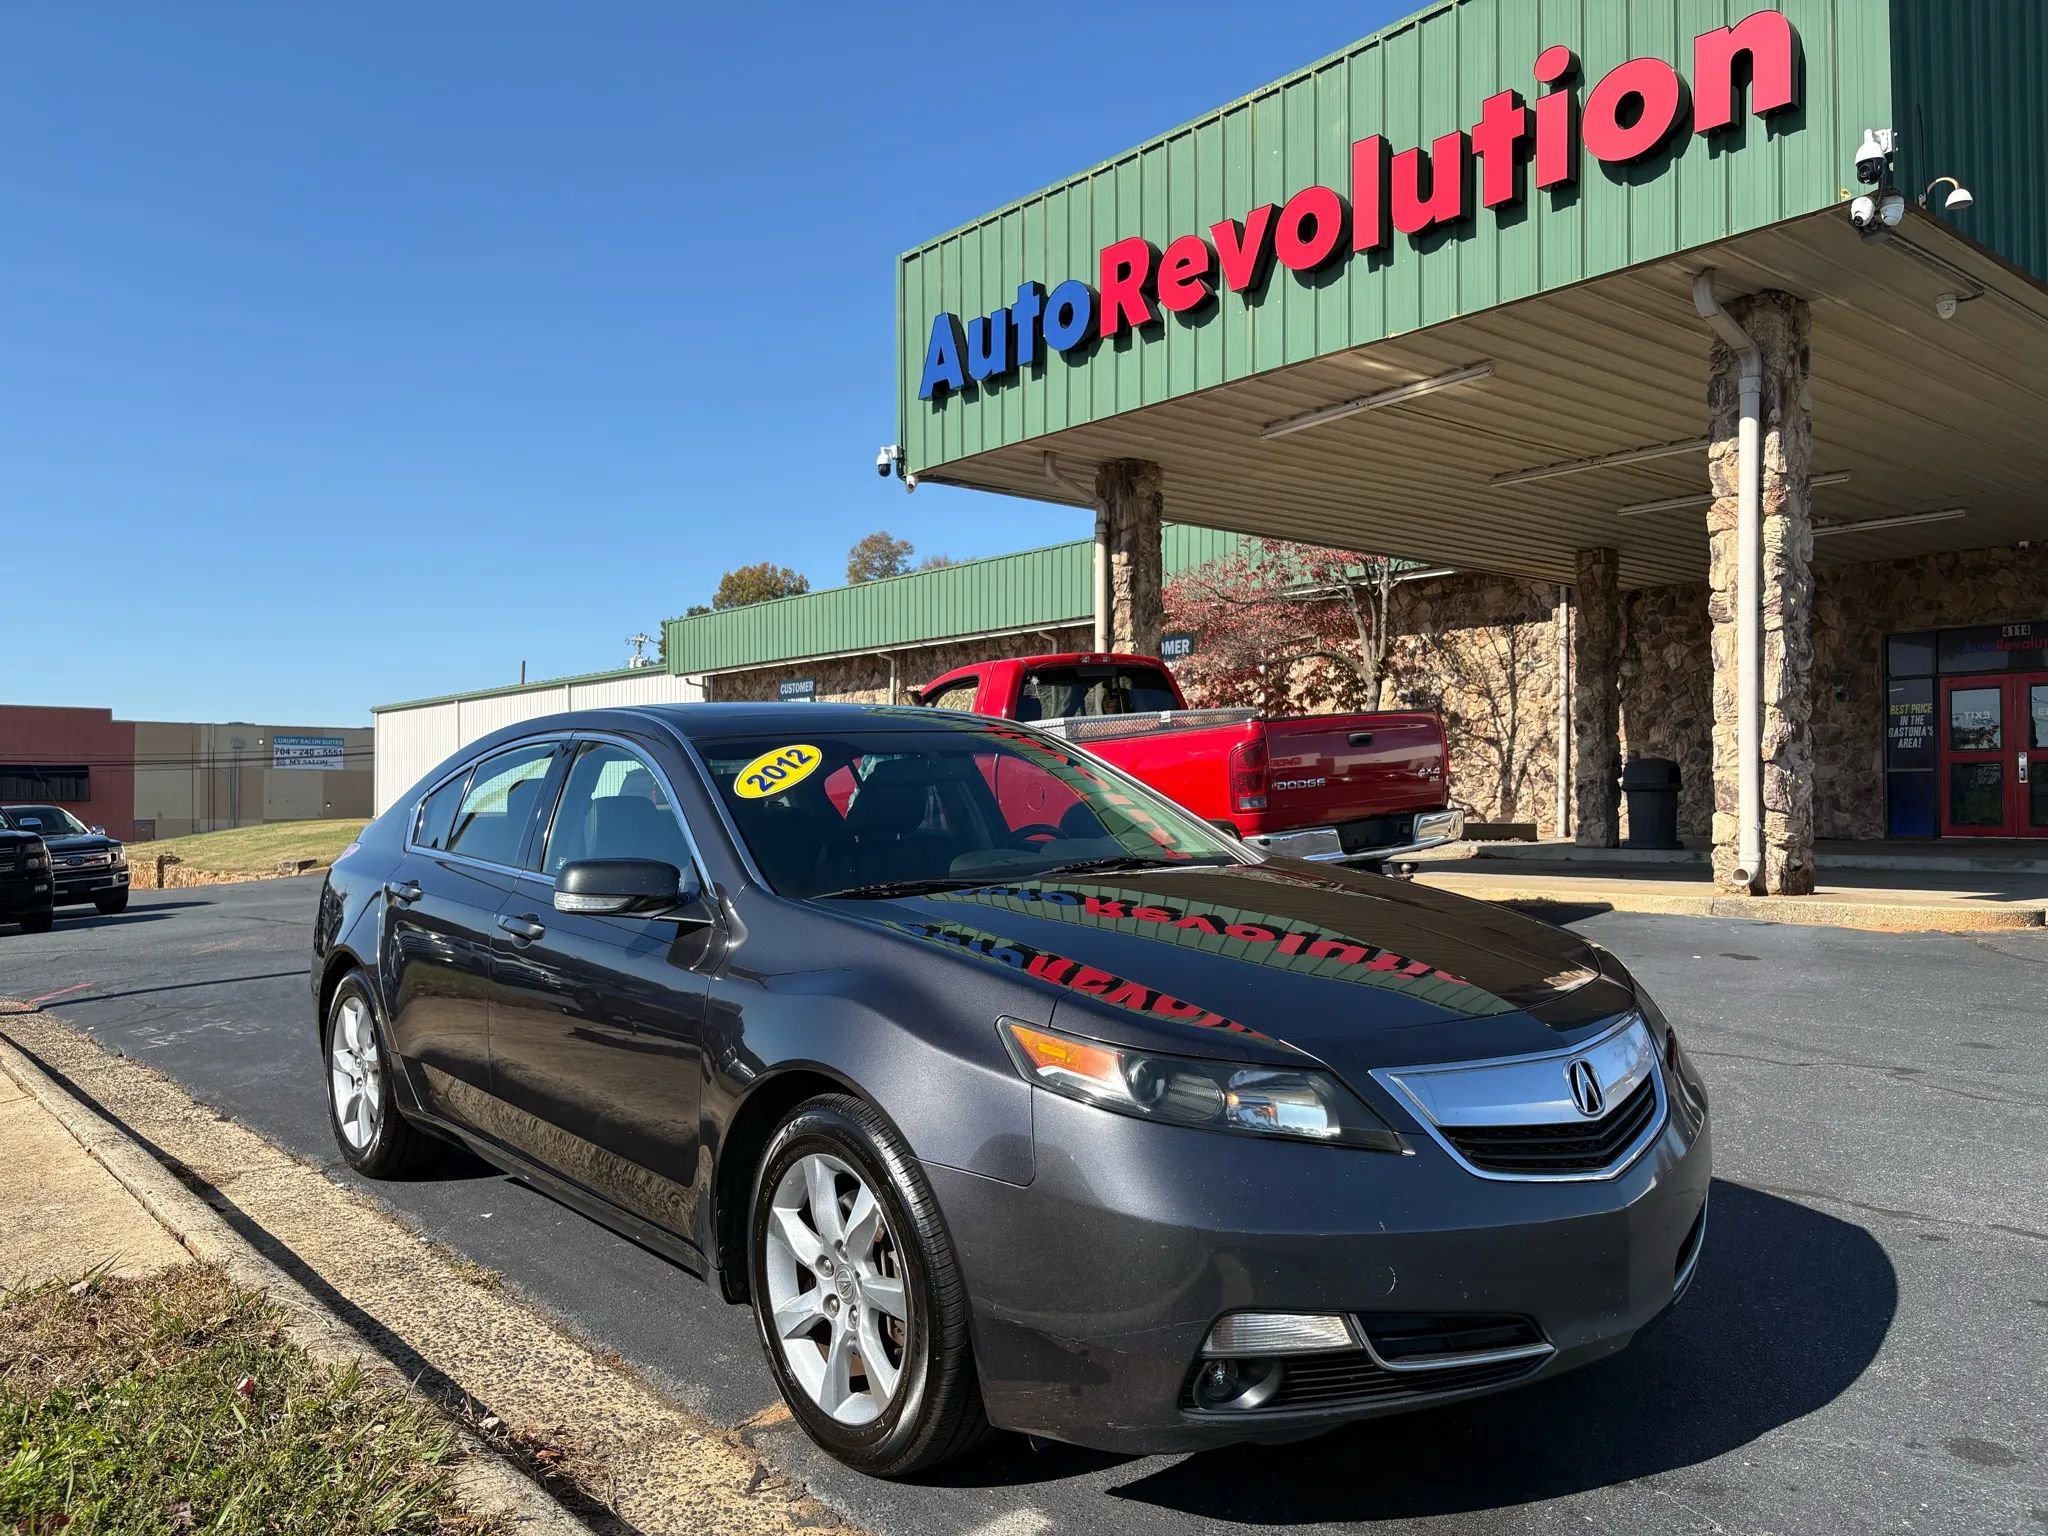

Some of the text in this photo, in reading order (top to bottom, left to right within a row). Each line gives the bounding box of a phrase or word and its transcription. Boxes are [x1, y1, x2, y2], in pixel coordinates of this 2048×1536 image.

[919, 10, 1804, 400] AutoRevolution
[780, 681, 814, 695] CUSTOMER
[1890, 703, 1932, 715] BEST PRICE
[1900, 715, 1925, 726] IN THE
[1888, 726, 1934, 738] GASTONIA'S
[274, 737, 299, 745] LUXURY
[300, 738, 321, 746] SALON
[1898, 738, 1922, 749] AREA!
[747, 749, 813, 792] 2012
[1277, 778, 1326, 791] DODGE
